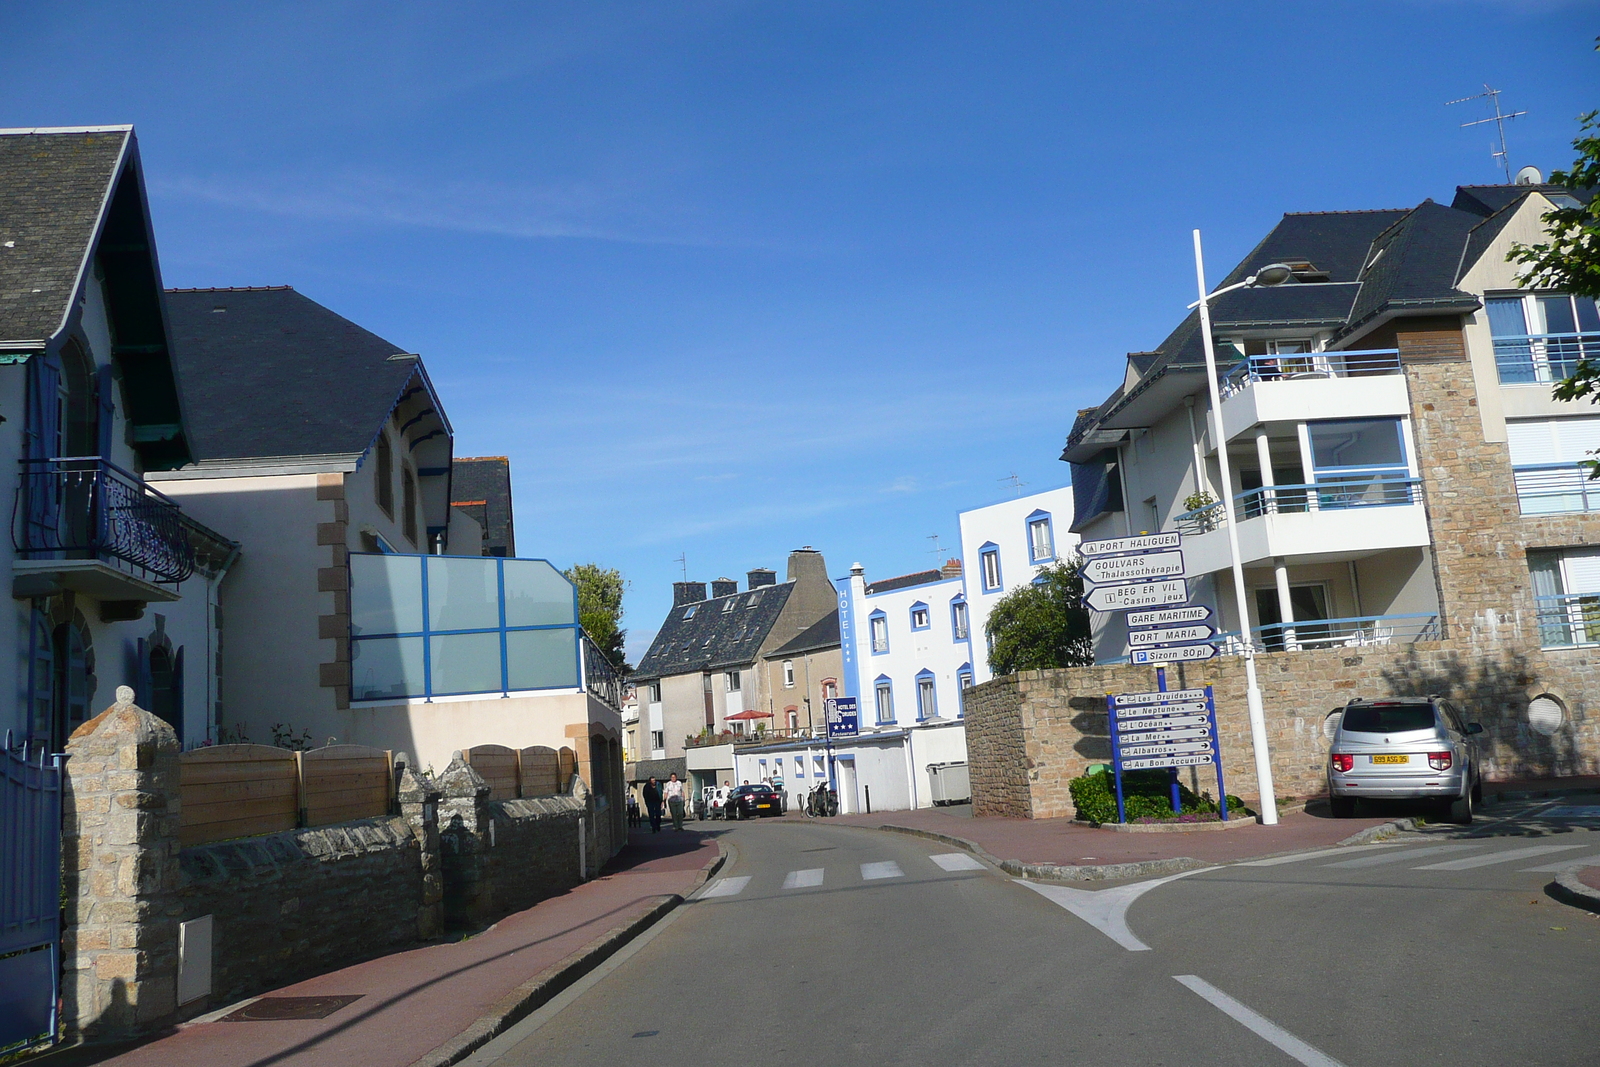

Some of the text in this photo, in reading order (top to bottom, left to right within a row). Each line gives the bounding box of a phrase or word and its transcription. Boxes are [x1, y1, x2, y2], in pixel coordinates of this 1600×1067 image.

[1100, 536, 1177, 550] PORT HALIGUEN
[1096, 558, 1144, 570] GOULVARS
[1118, 583, 1177, 596] BEG ER VIL
[1164, 594, 1184, 603] jeux
[840, 590, 850, 639] HOTEL
[1132, 610, 1203, 624] GARE MARITIME
[1133, 630, 1197, 642] PORT MARIA
[1150, 650, 1178, 660] Sizorn
[1182, 649, 1195, 657] 80
[1156, 692, 1188, 700] Druides
[1142, 706, 1176, 716] Neptune
[1133, 746, 1166, 754] Albatros
[1170, 756, 1200, 764] Accueil
